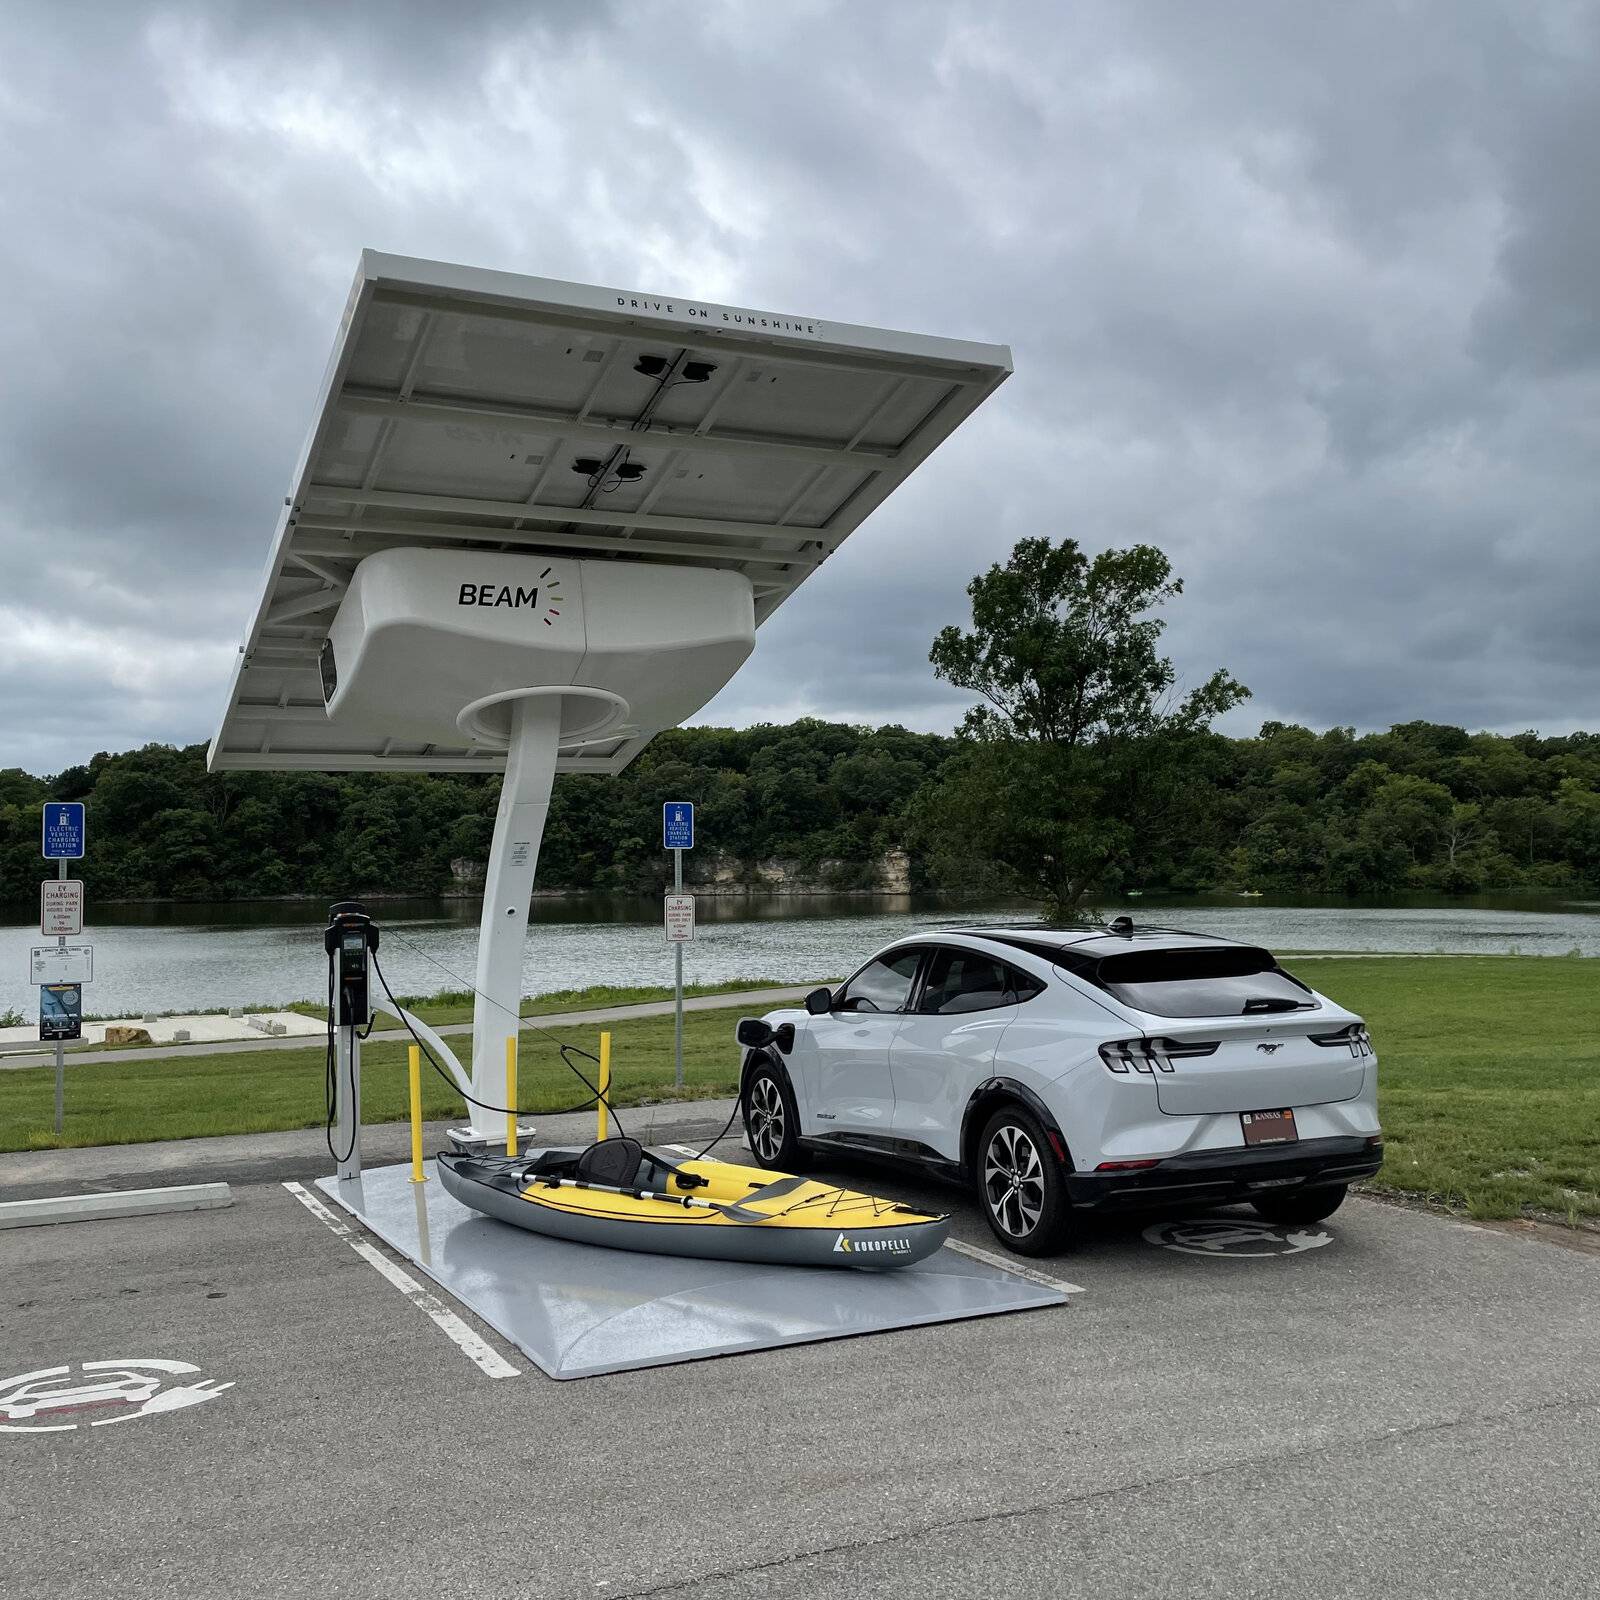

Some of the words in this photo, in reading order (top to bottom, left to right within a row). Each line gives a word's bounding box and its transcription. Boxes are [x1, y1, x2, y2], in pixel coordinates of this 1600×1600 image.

[617, 298, 673, 312] DRIVE
[688, 308, 707, 317] ON
[722, 313, 814, 333] SUNSHINE
[459, 583, 538, 608] BEAM
[1255, 1111, 1281, 1120] KANSAS
[854, 1239, 911, 1252] KOKOPELLI
